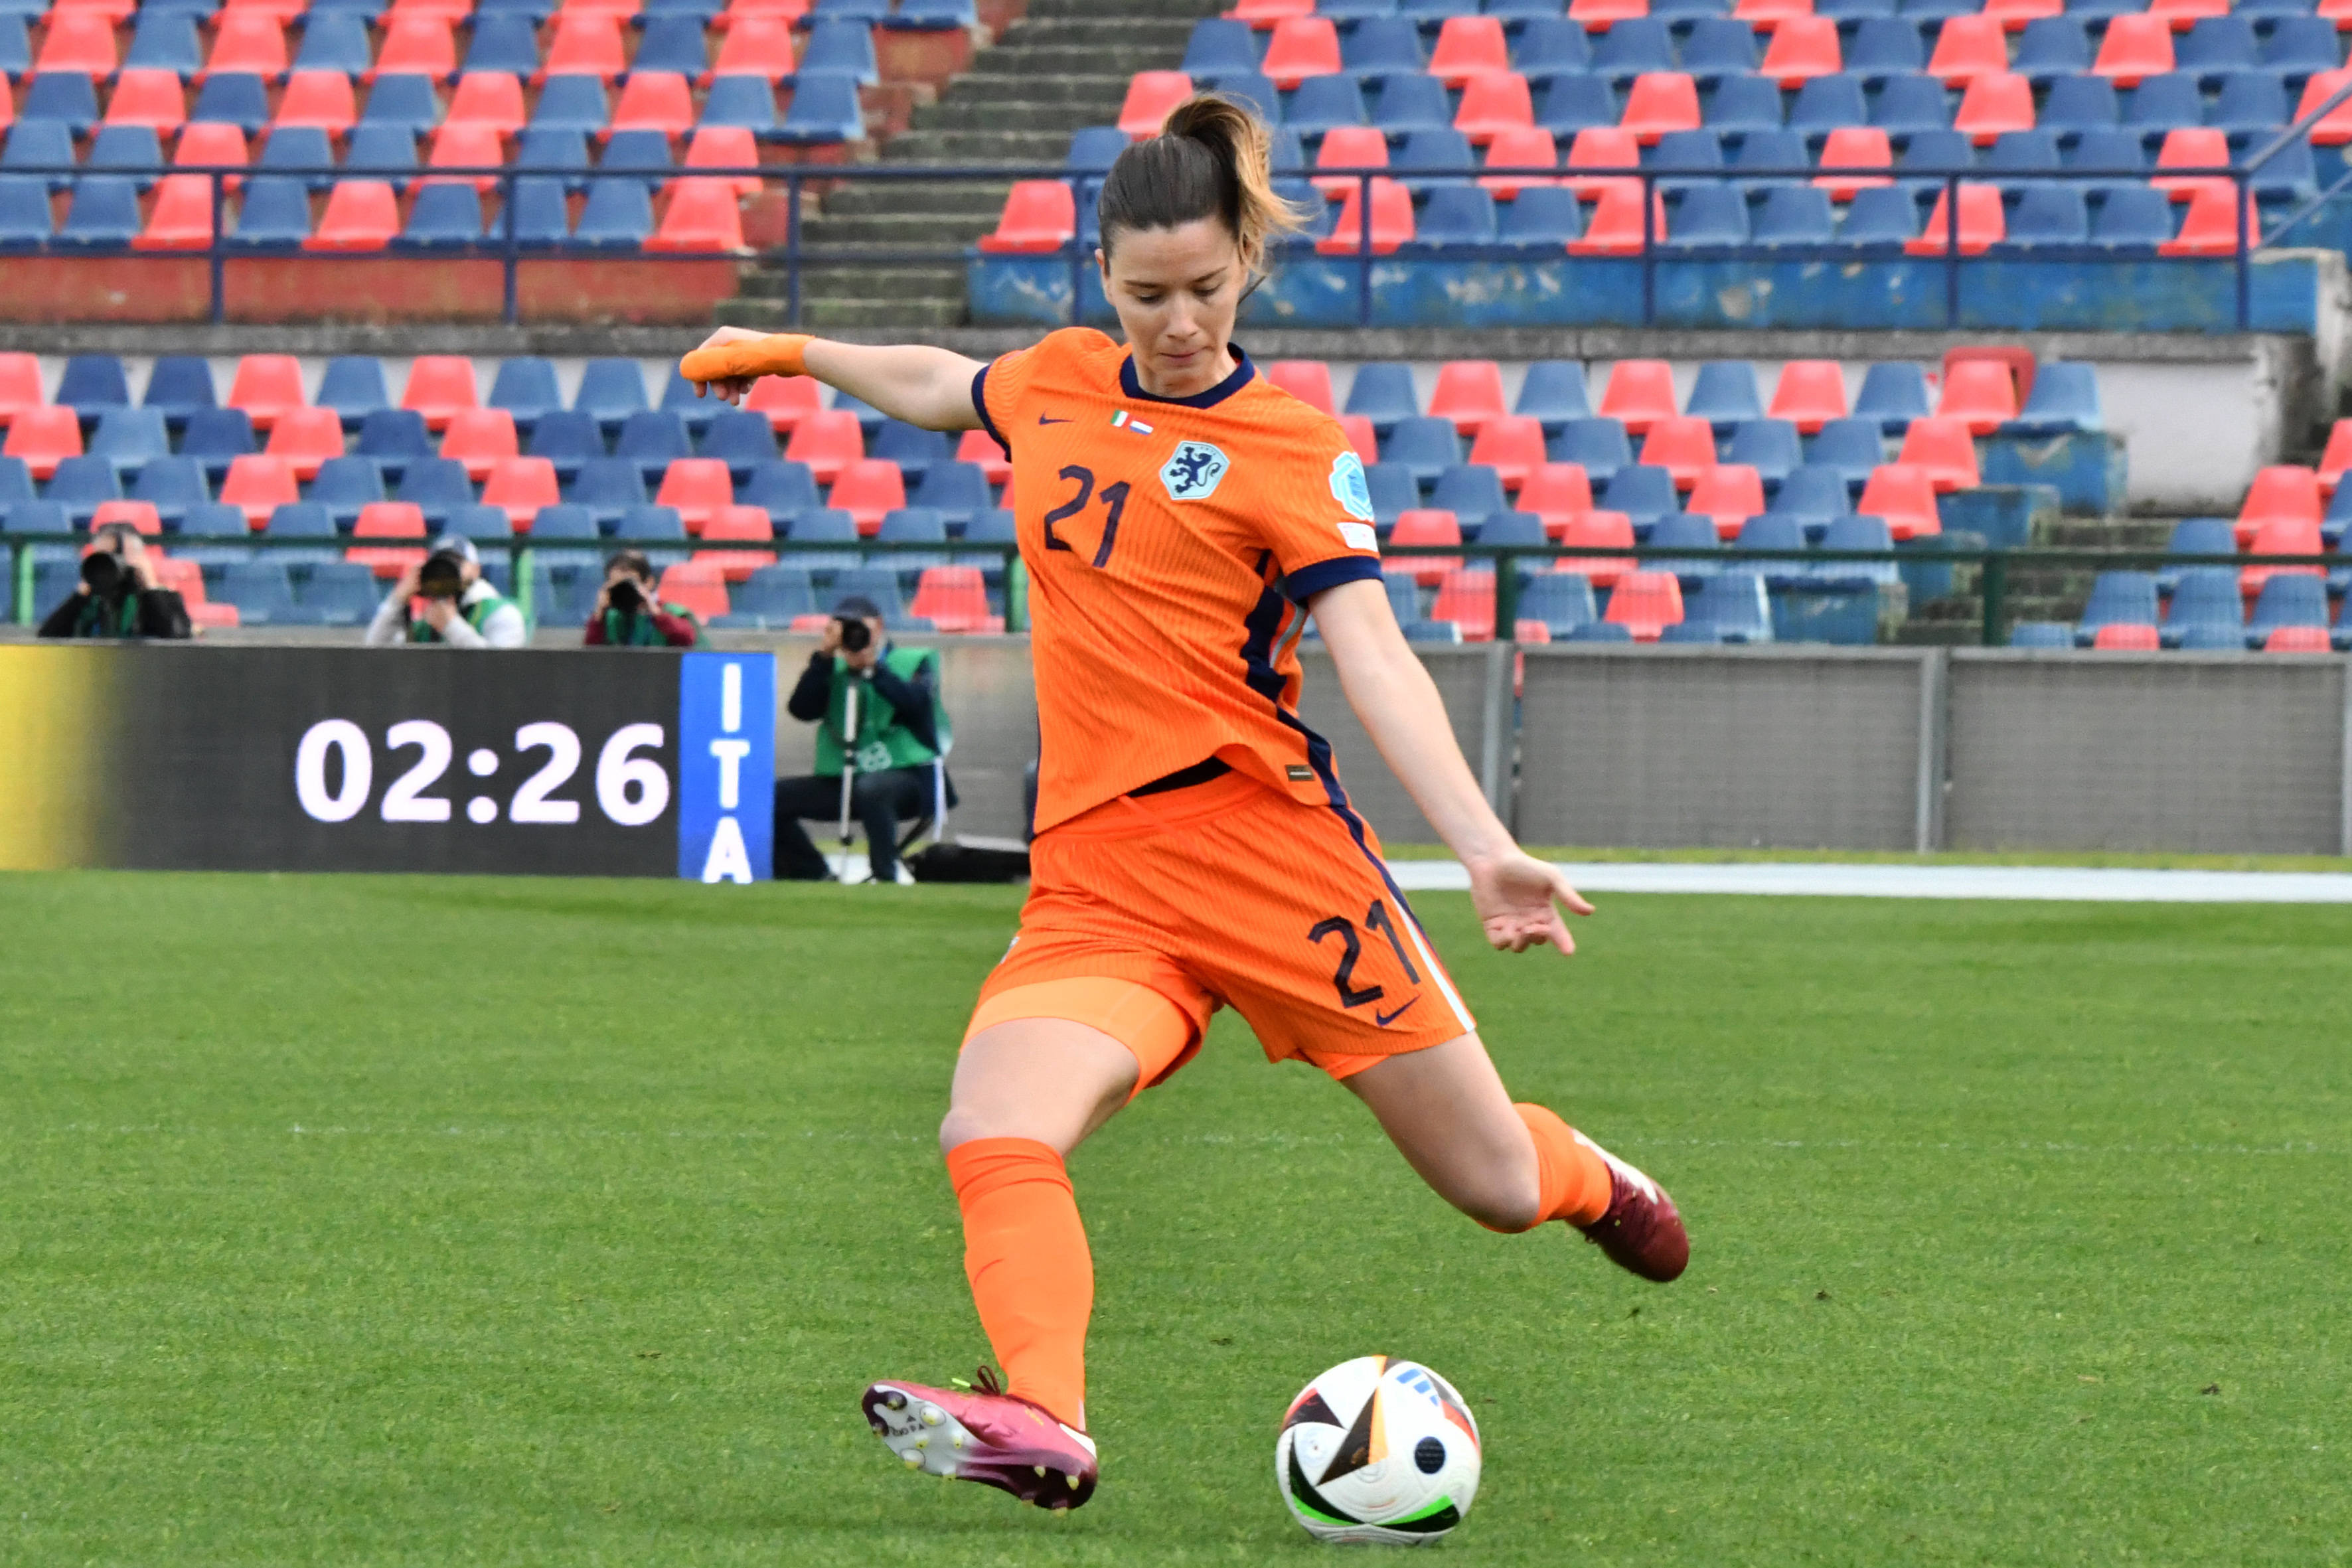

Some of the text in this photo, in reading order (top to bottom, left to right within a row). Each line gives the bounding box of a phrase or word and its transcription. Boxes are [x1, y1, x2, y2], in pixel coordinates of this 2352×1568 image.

[1043, 464, 1131, 568] 21
[295, 718, 670, 826] 02:26
[703, 663, 753, 884] ITA
[1306, 898, 1421, 1009] 21
